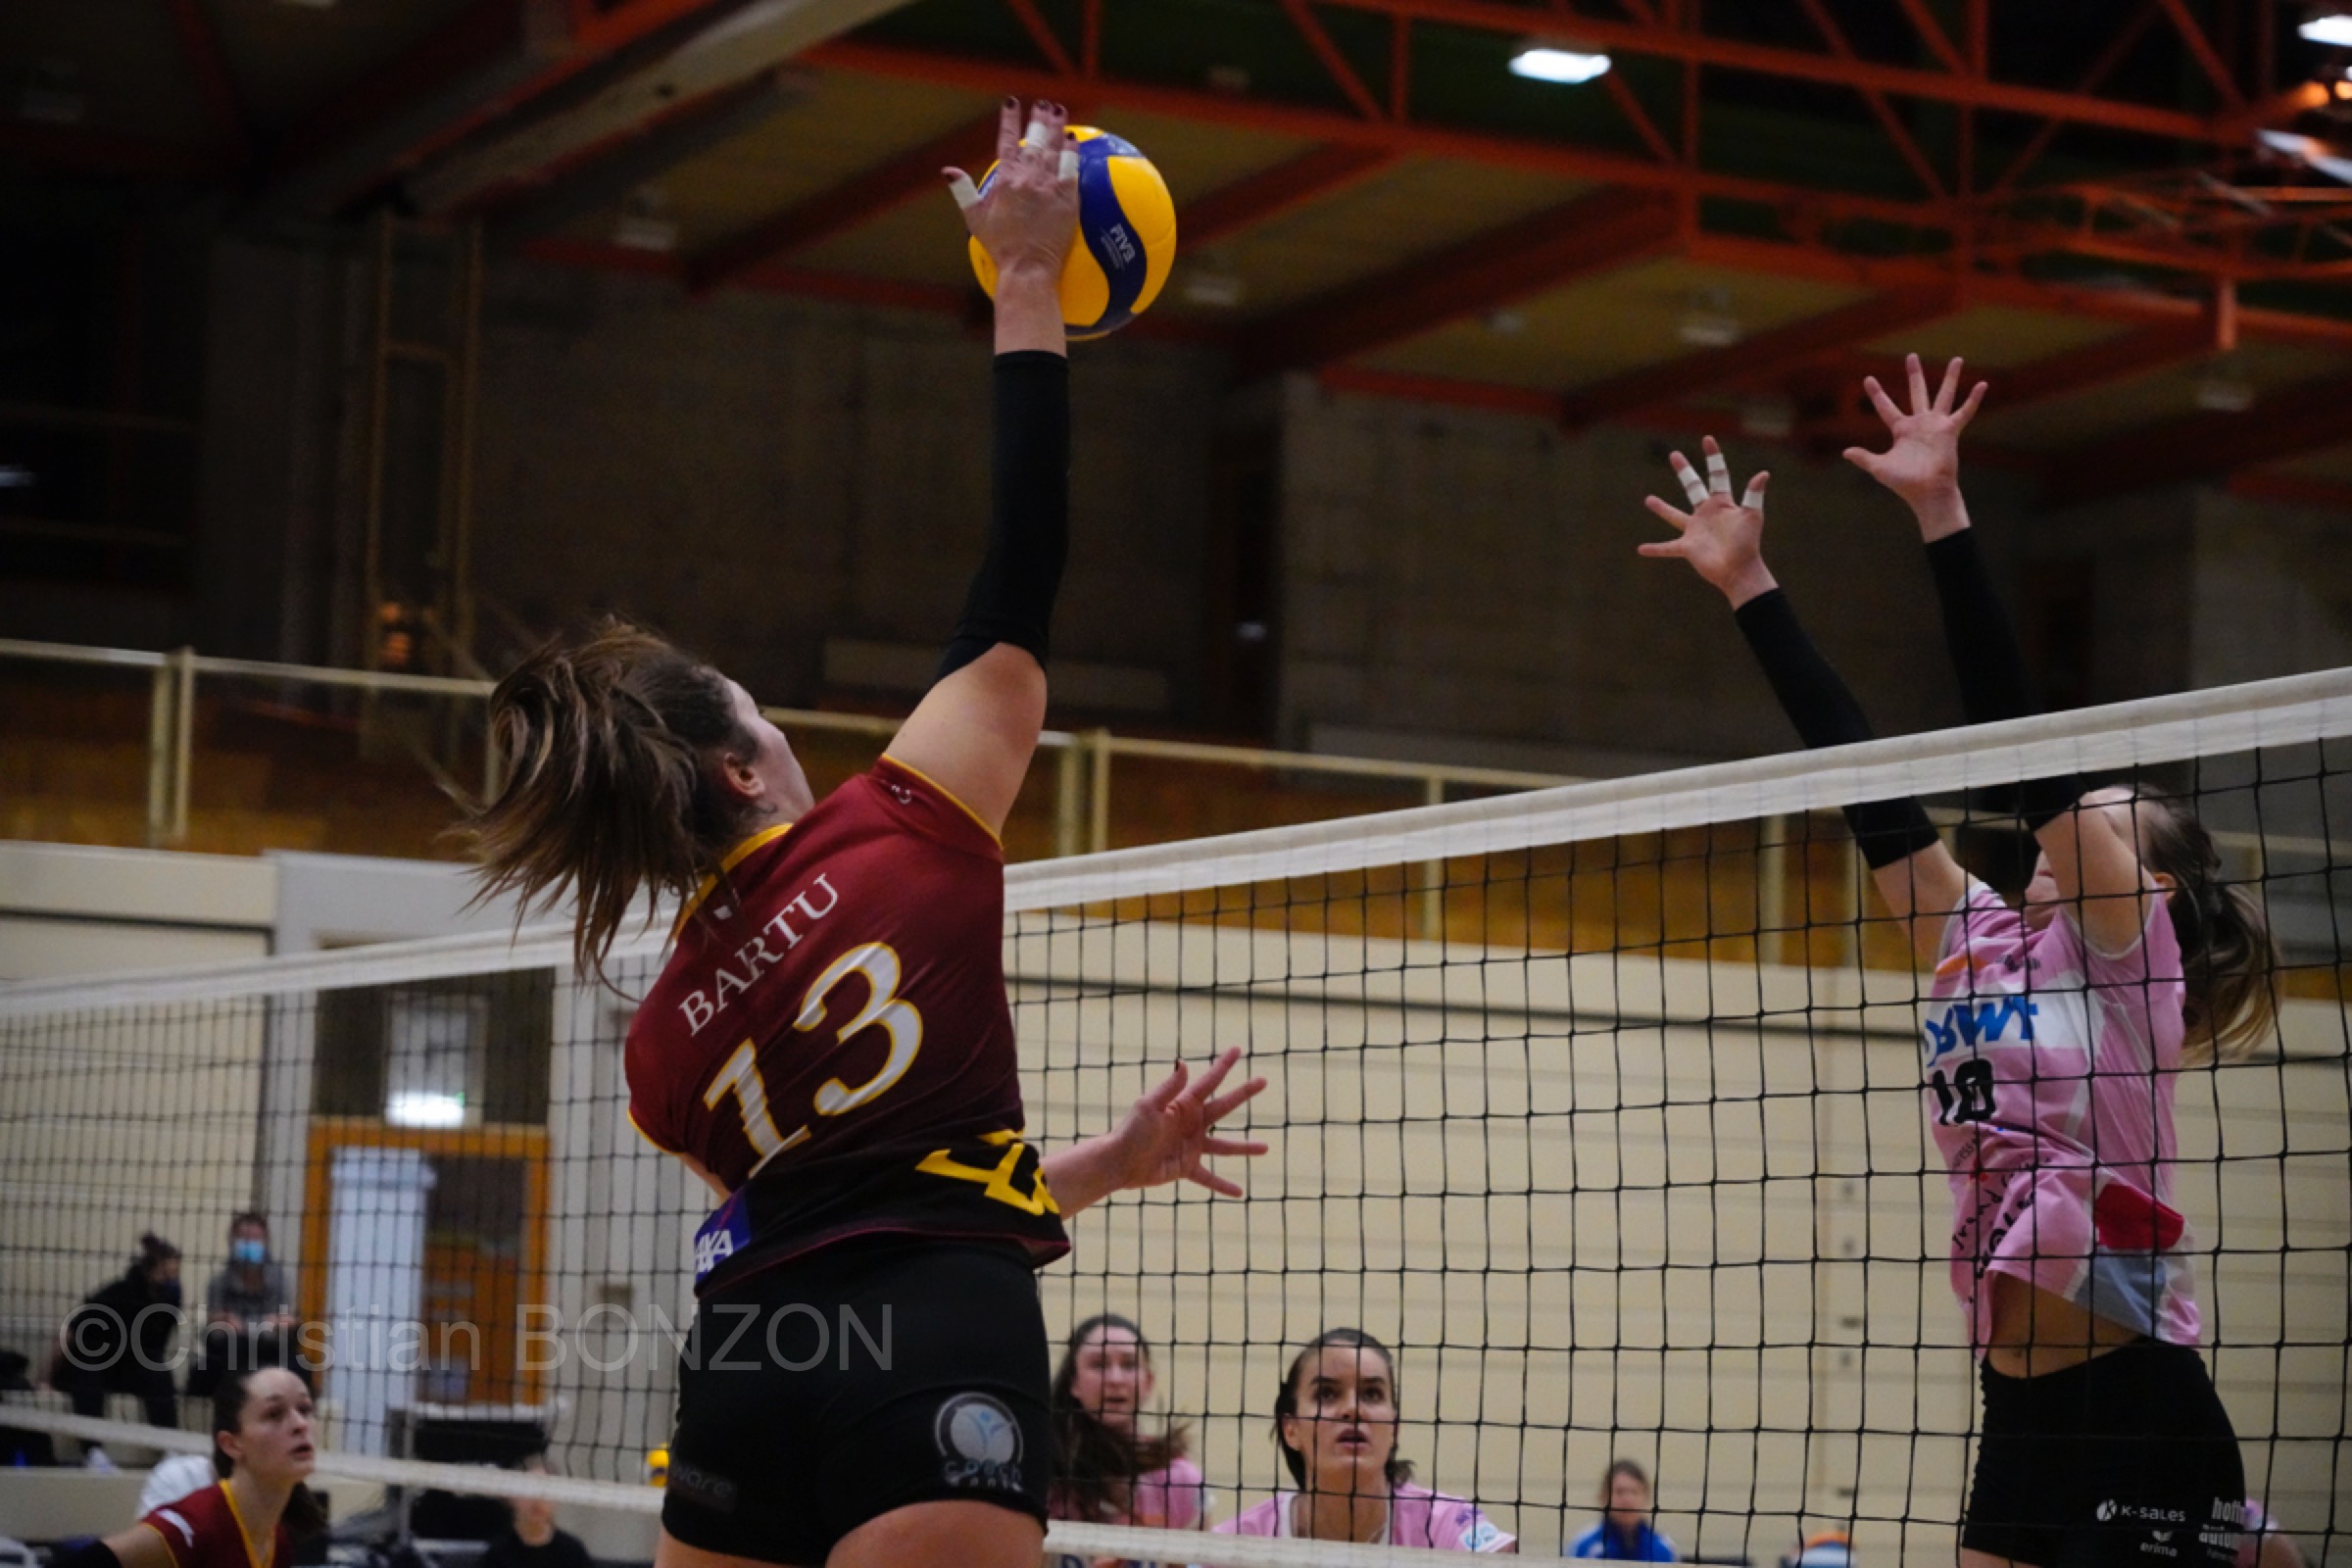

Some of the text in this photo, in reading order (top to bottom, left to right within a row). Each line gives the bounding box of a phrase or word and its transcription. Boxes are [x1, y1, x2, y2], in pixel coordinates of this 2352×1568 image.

[678, 873, 840, 1036] BARTU
[702, 941, 923, 1179] 13
[2139, 1542, 2179, 1557] erima
